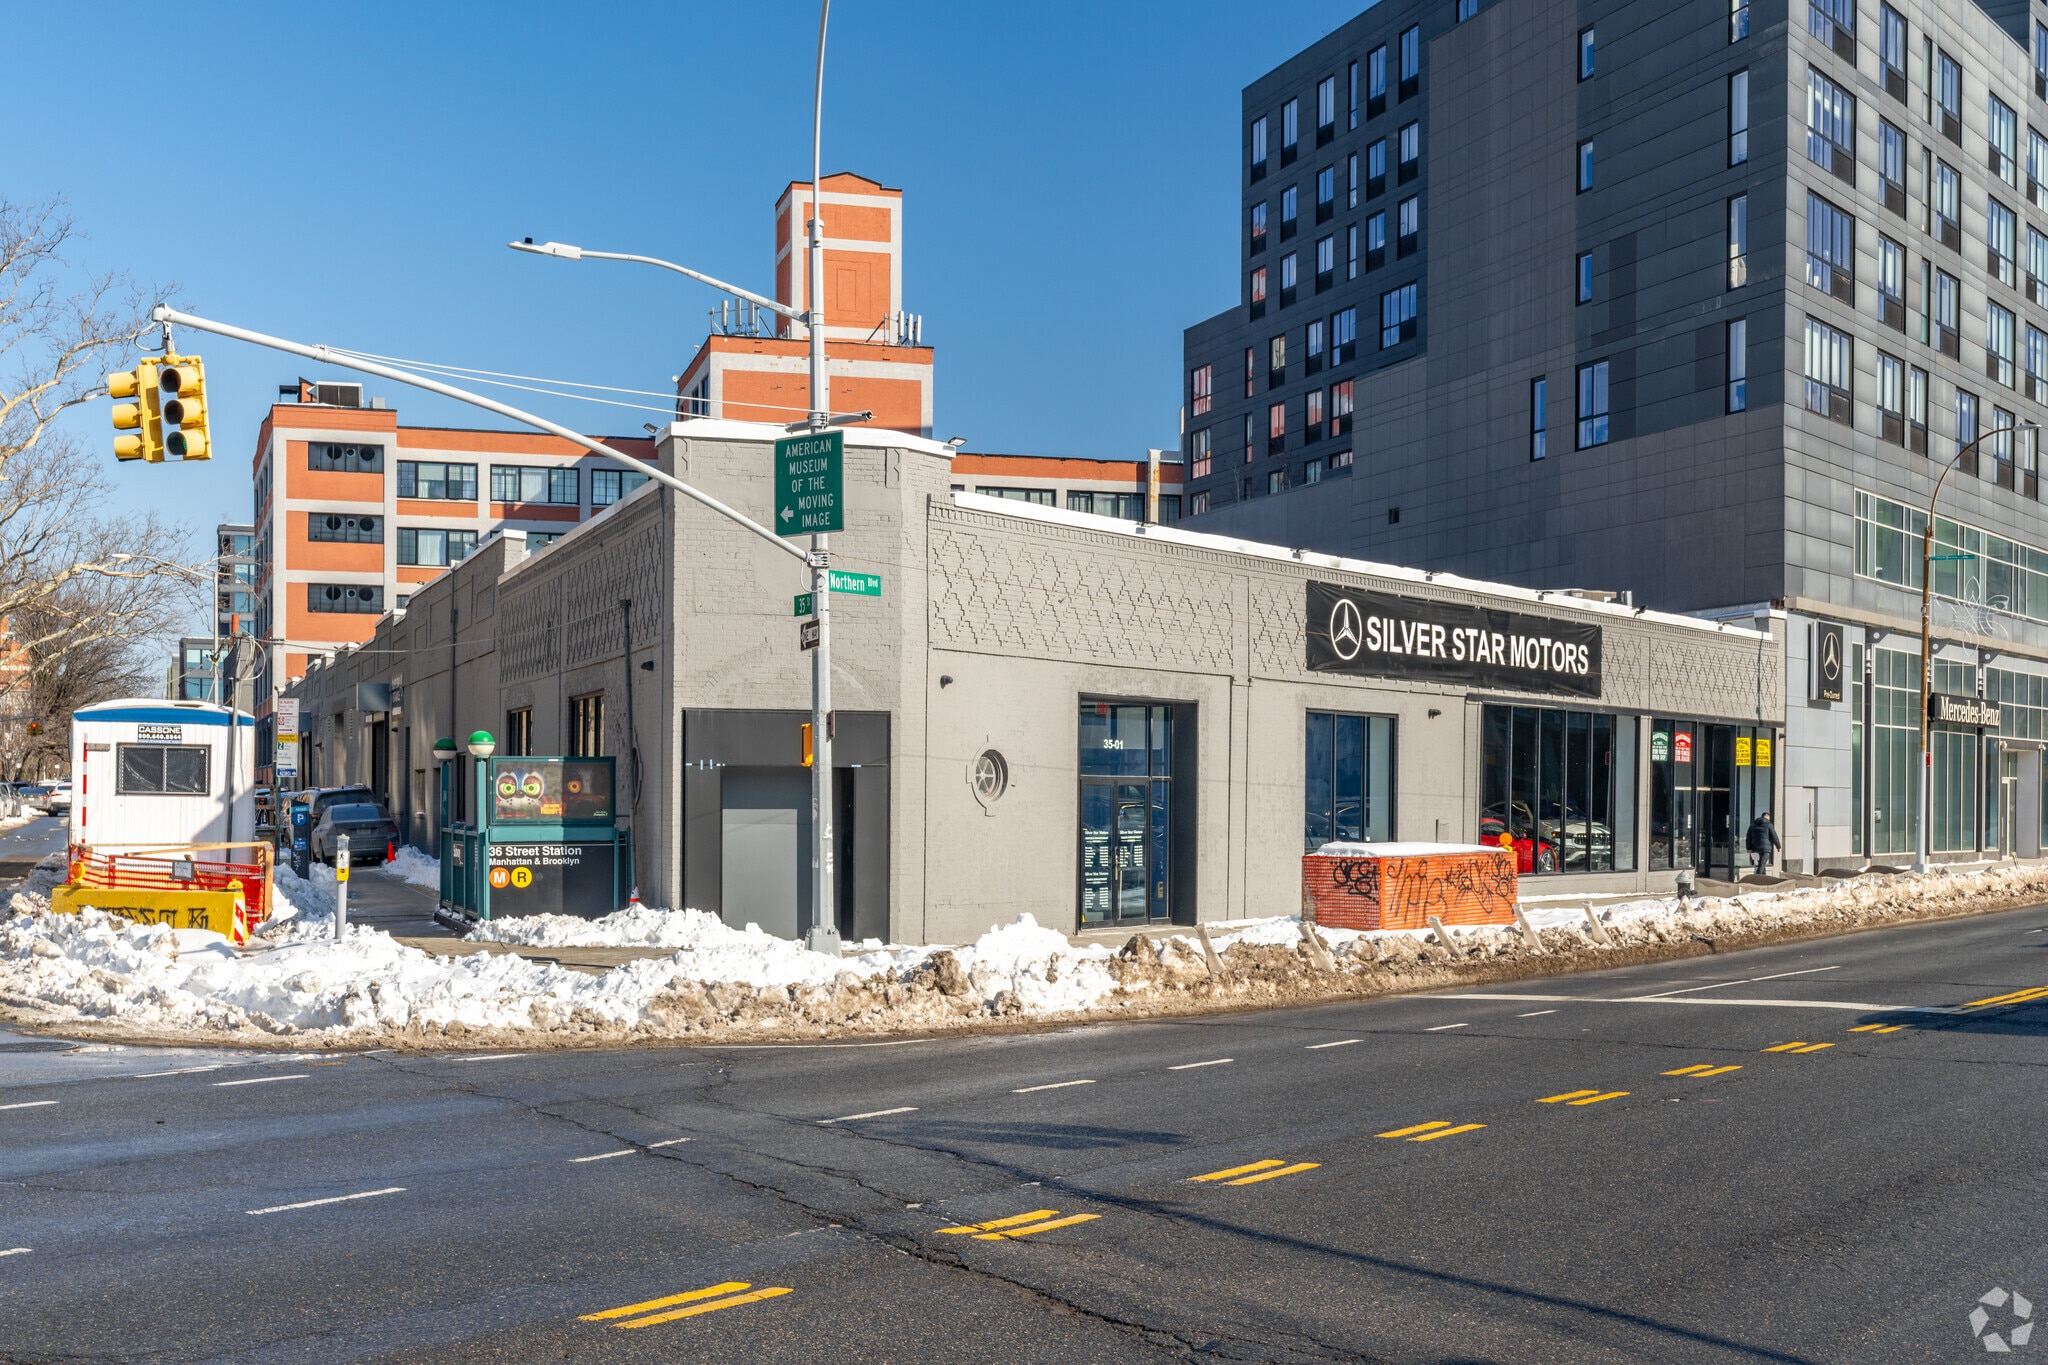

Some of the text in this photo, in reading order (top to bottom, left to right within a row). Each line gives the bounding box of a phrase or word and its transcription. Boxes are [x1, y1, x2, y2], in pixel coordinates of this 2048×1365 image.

[785, 439, 832, 458] AMERICAN
[789, 458, 828, 475] MUSEUM
[791, 476, 825, 493] OF THE
[798, 493, 834, 510] MOVING
[802, 511, 830, 527] IMAGE
[830, 573, 879, 592] Northern Blvd
[1366, 616, 1589, 675] SILVER STAR MOTORS
[1940, 696, 1999, 727] Mercedes-Benz
[138, 726, 181, 734] CASSONE
[1103, 739, 1124, 750] 35-01
[489, 847, 502, 857] 36
[505, 846, 539, 856] Street
[542, 845, 582, 856] Station
[489, 857, 580, 866] Manhattan & Brooklyn
[493, 872, 527, 884] M R
